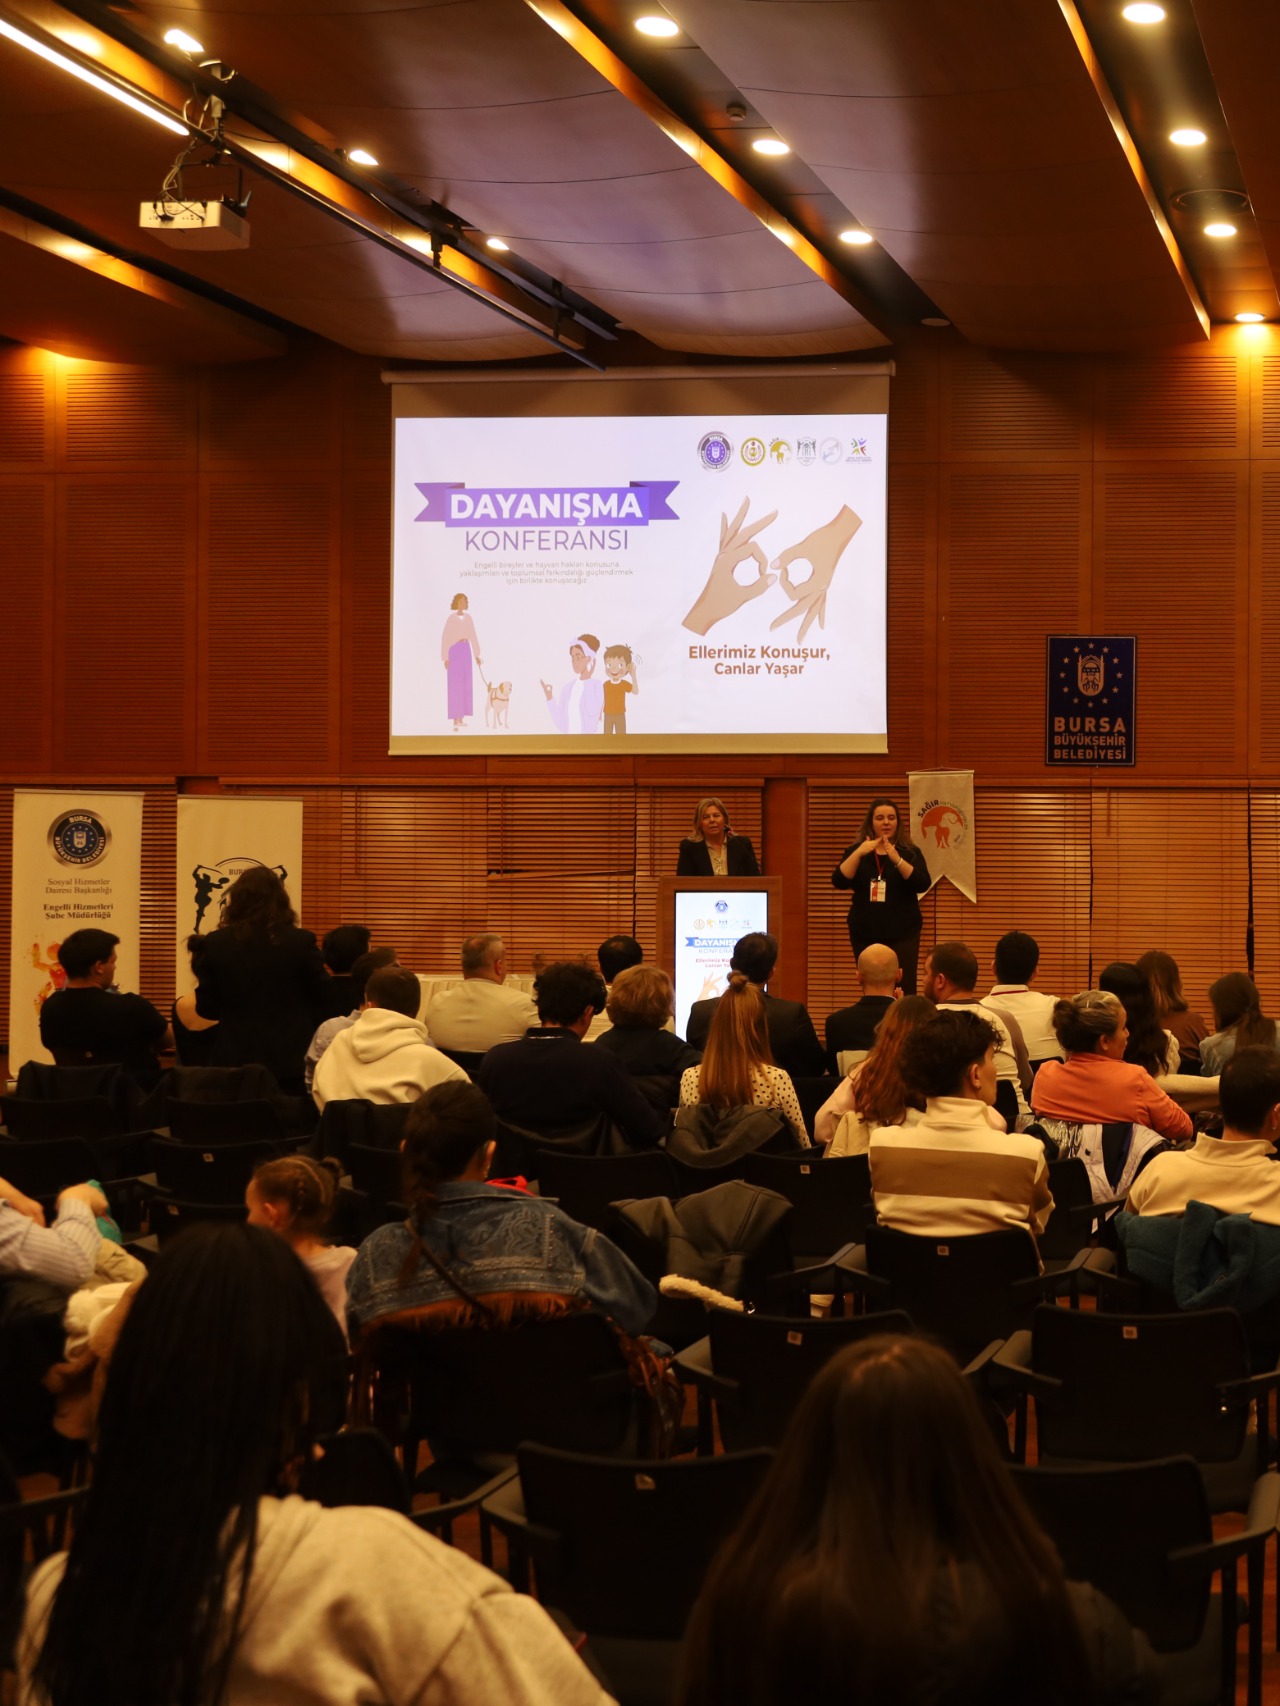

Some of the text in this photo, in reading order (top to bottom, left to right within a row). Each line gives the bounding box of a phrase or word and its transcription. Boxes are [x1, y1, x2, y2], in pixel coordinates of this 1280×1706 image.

[451, 493, 643, 526] DAYANIŞMA
[466, 529, 628, 551] KONFERANSI
[474, 562, 498, 570] Engelli
[586, 569, 634, 577] güçlendirmek
[506, 577, 519, 585] için
[688, 644, 831, 662] Ellerimiz Konuşur,
[714, 662, 804, 678] Canlar Yaşar
[1054, 717, 1126, 733] BURSA
[1054, 733, 1126, 746] BÜYÜKŞEHİR
[1053, 747, 1126, 760] BELEDİYESİ
[917, 799, 939, 818] SAĞIR
[68, 815, 92, 824] BURSA
[47, 878, 73, 887] Sosyal
[45, 886, 112, 895] Dairesi Başkanlığı
[43, 903, 114, 912] Engelli Hizmetleri
[45, 911, 111, 920] Şube Müdürlüğü
